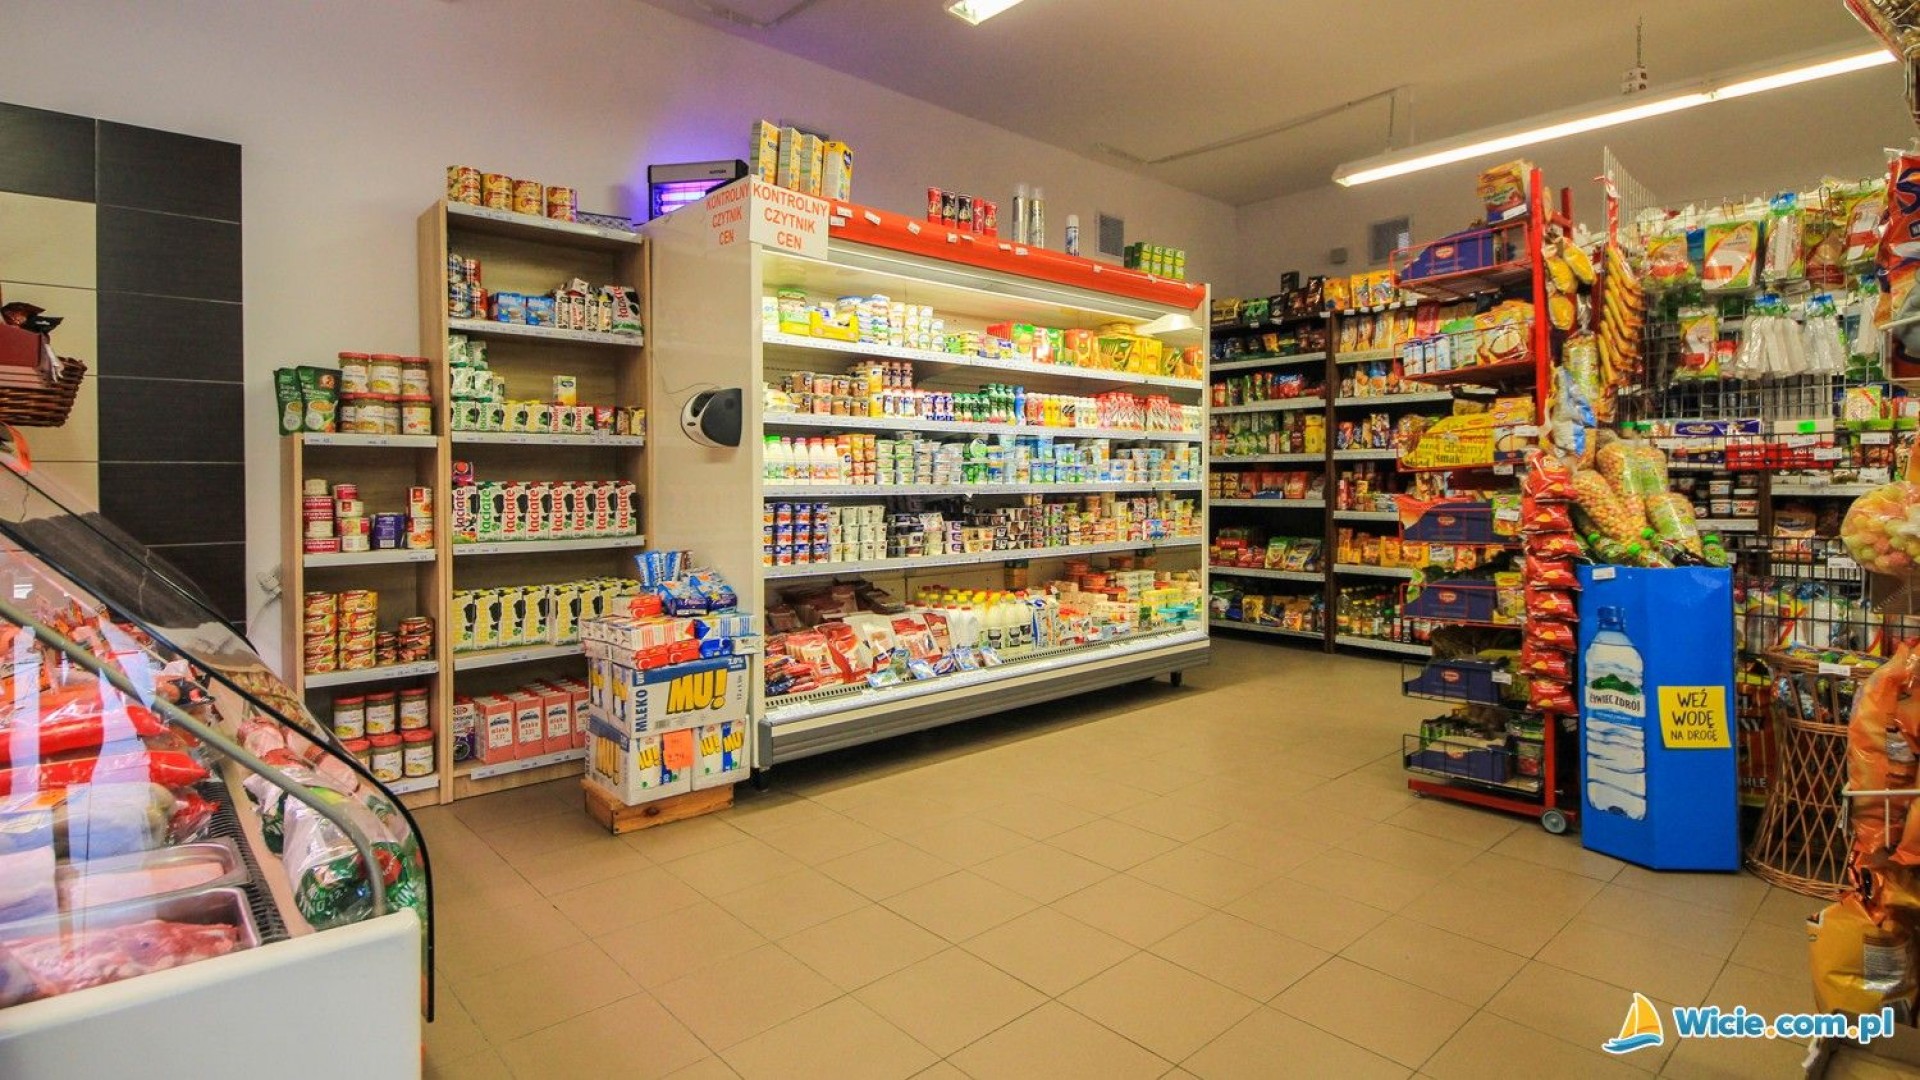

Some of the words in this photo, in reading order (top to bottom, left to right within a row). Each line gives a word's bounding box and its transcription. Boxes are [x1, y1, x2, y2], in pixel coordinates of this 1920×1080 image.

[706, 183, 750, 211] KONTROLNY
[753, 183, 827, 218] KONTROLNY
[712, 206, 742, 228] CZYTNIK
[764, 207, 815, 234] CZYTNIK
[719, 229, 735, 245] CEN
[777, 231, 802, 250] CEN
[667, 668, 728, 714] MU!
[1677, 688, 1708, 708] WEŹ
[635, 689, 648, 733] MLEKO
[1672, 710, 1714, 729] WODĘ
[1671, 730, 1683, 741] NA
[1687, 730, 1718, 742] DROGĘ
